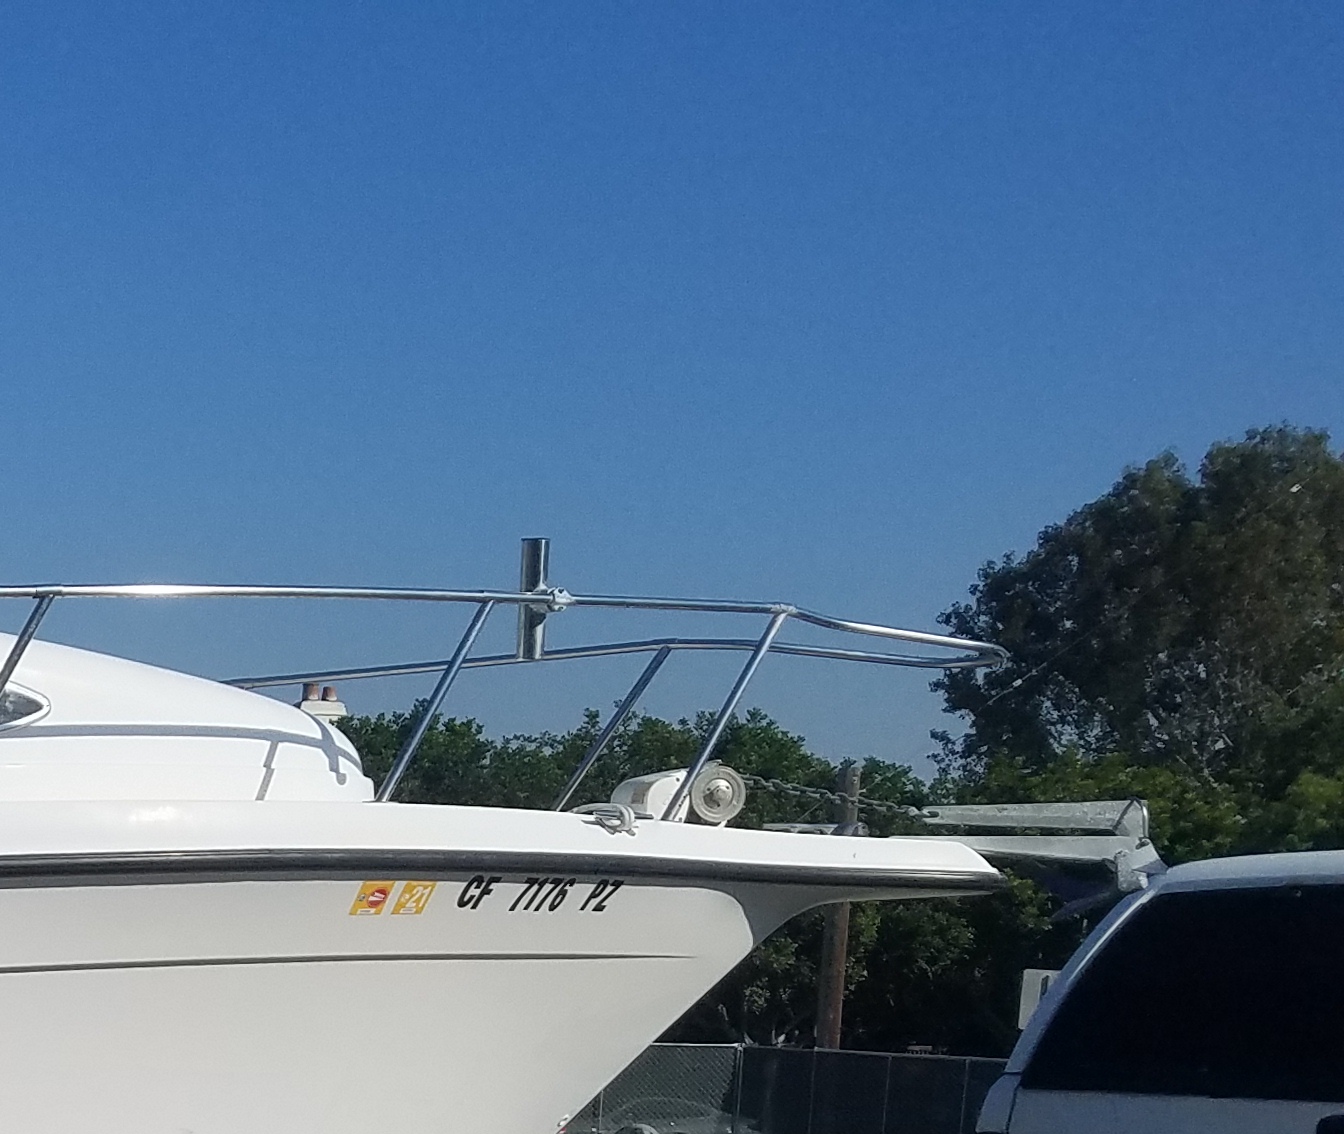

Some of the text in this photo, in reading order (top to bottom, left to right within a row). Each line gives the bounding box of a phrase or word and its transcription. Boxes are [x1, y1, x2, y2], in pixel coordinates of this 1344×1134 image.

[404, 885, 432, 908] 21
[457, 875, 624, 912] CF 7176 PZ
